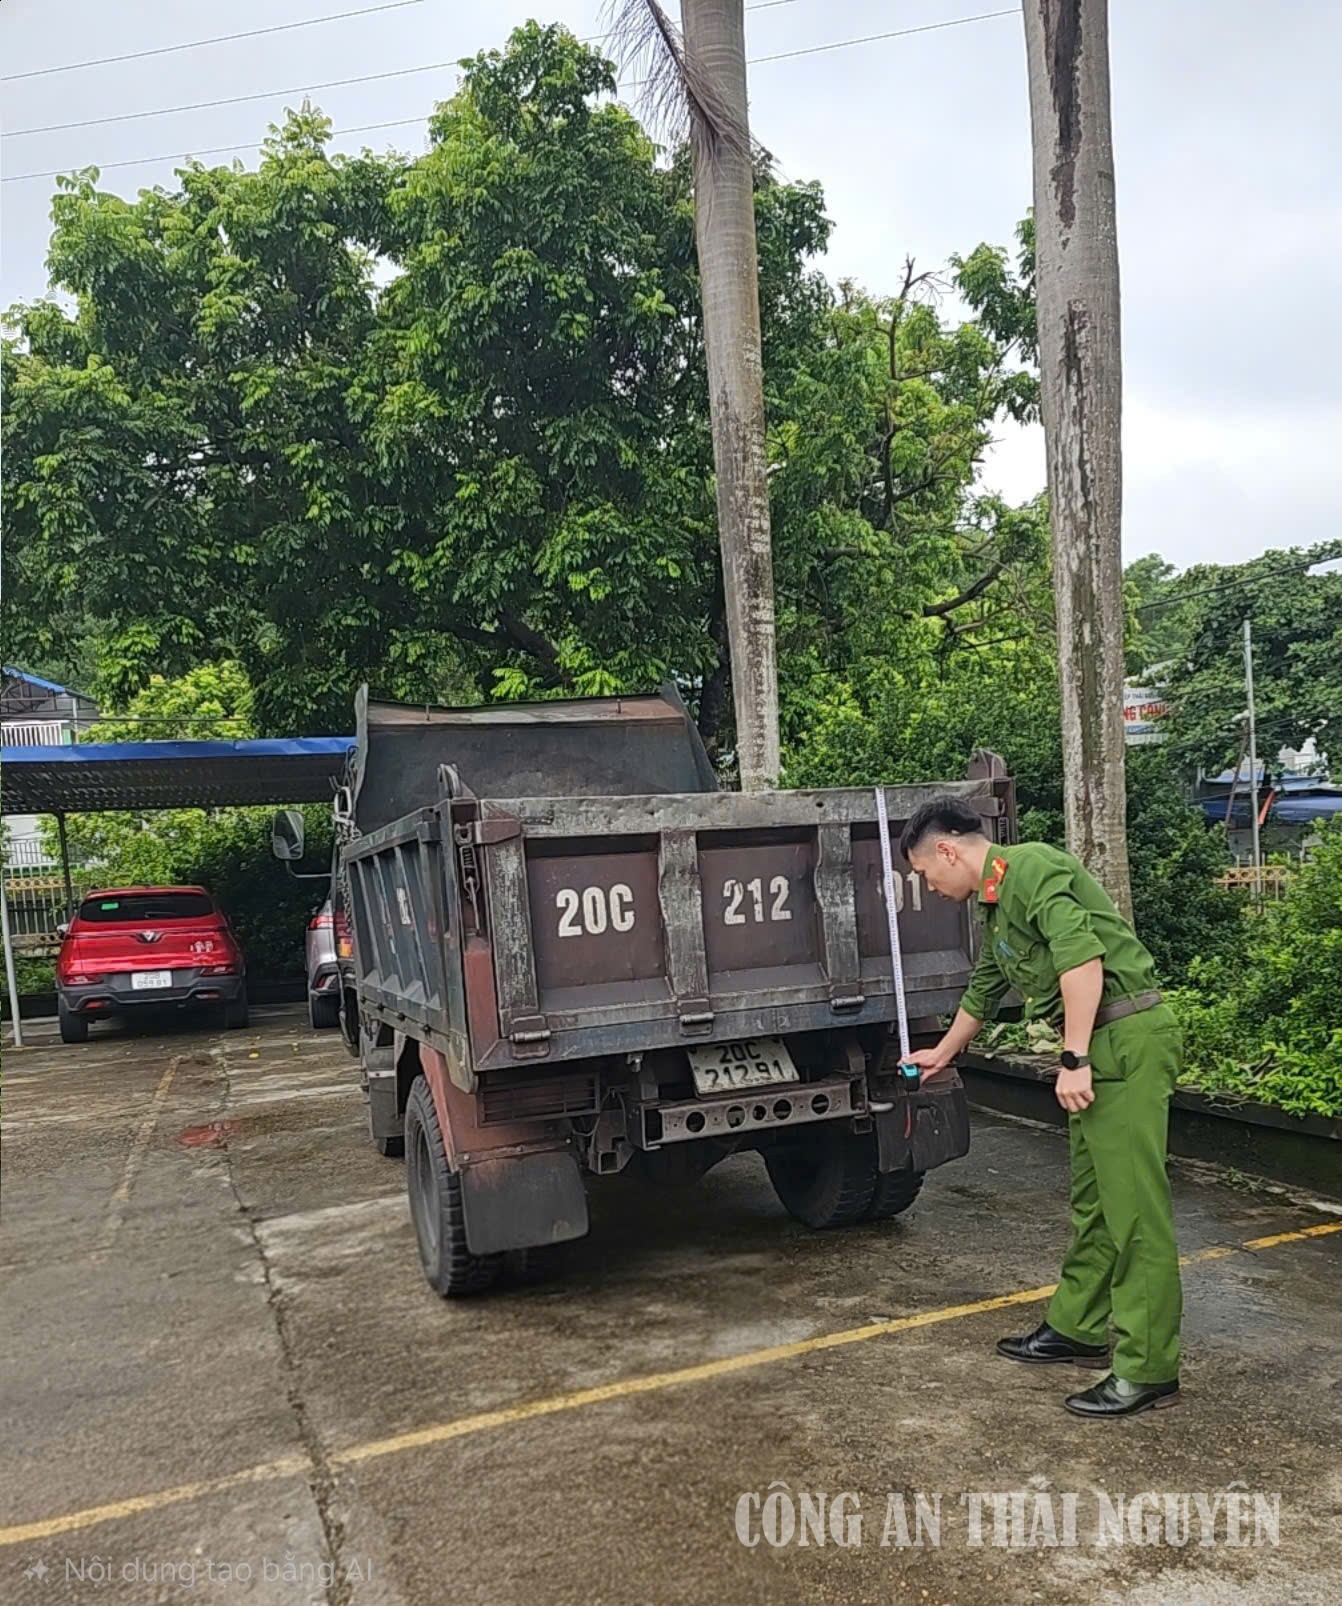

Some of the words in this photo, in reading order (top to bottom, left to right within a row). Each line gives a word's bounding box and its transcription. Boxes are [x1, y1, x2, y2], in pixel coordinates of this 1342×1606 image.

[556, 883, 635, 938] 20C
[723, 875, 792, 925] 212
[714, 1041, 761, 1064] 20C
